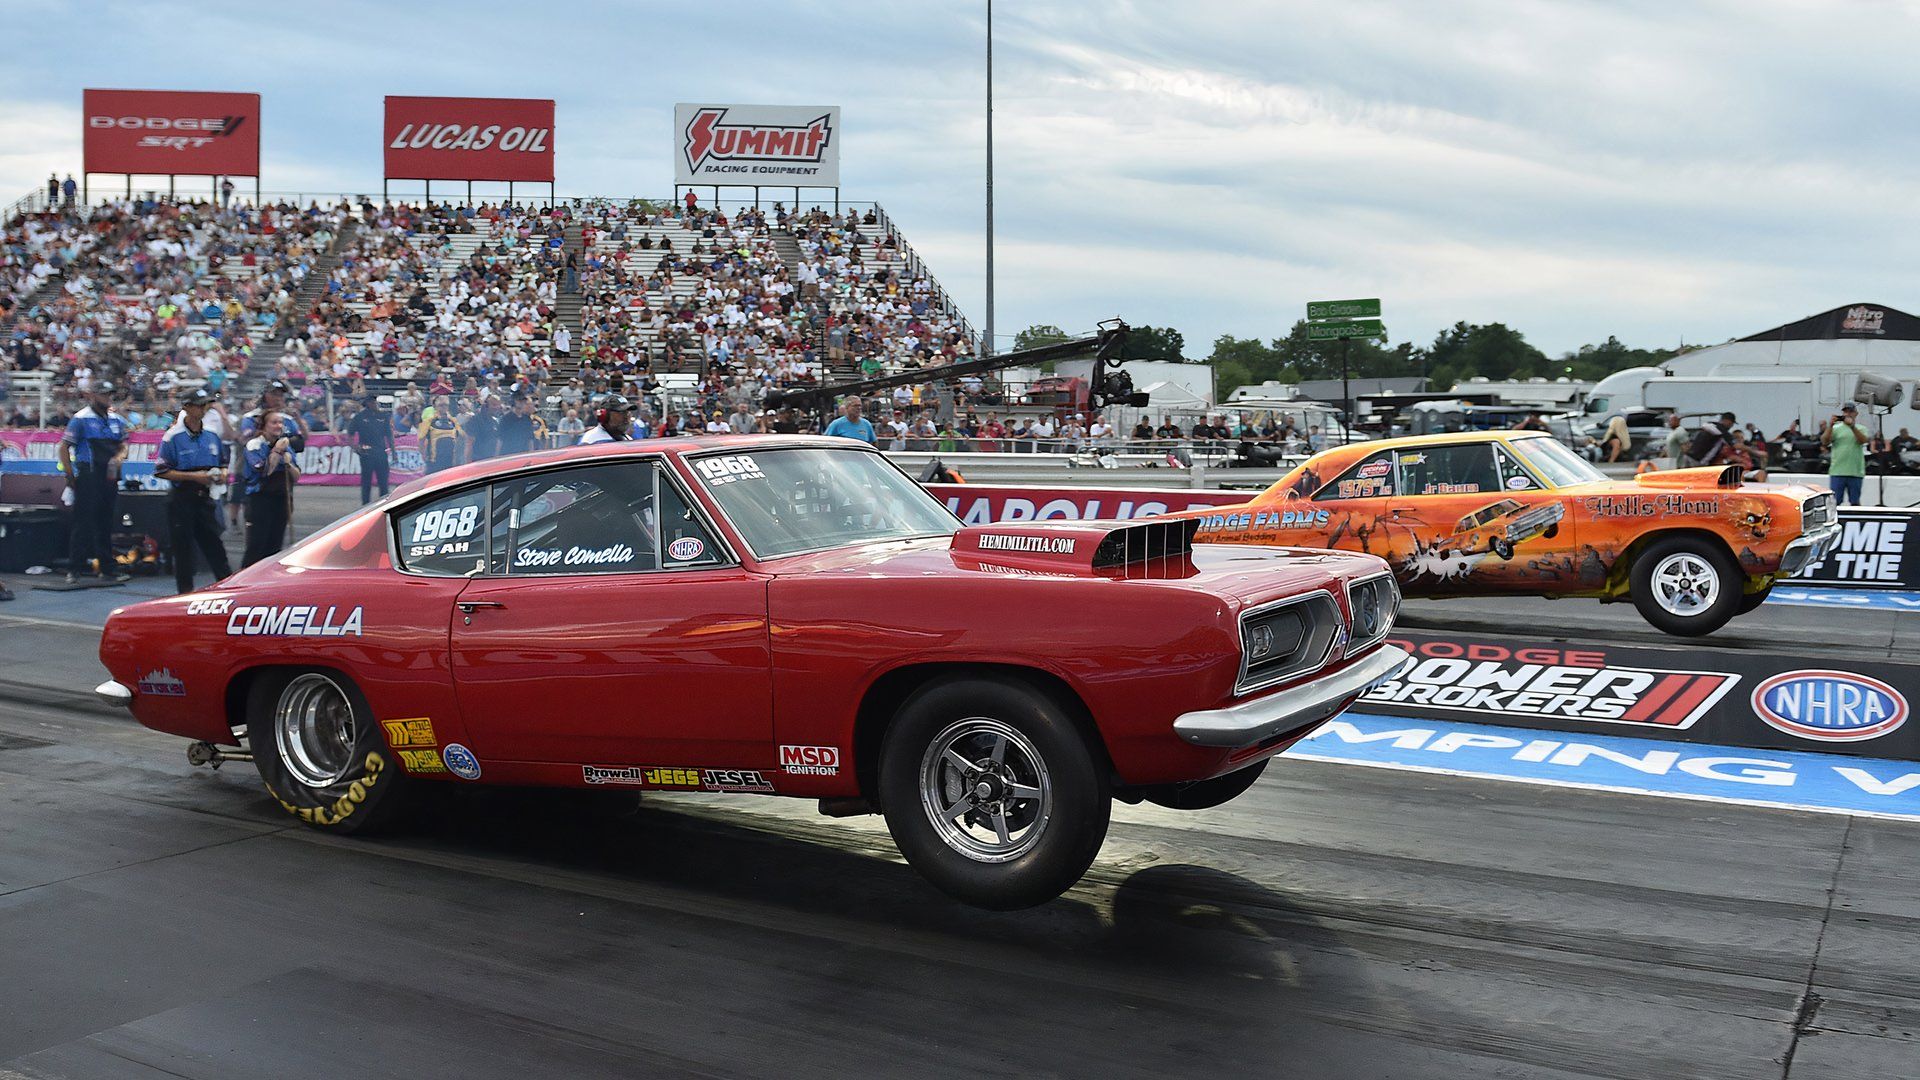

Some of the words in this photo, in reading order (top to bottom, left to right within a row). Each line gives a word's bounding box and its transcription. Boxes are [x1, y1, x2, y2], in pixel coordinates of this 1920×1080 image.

[90, 116, 225, 130] DODGE
[137, 136, 214, 150] SRT
[390, 124, 501, 151] LUCAS
[499, 126, 549, 152] OIL
[705, 165, 748, 174] RACING
[752, 166, 819, 175] EQUIPMENT
[695, 455, 760, 480] 1968
[709, 475, 737, 486] SS
[740, 471, 766, 480] AH
[412, 505, 479, 542] 1968
[1253, 510, 1330, 530] FARMS
[410, 545, 437, 556] SS
[440, 541, 469, 554] AH
[673, 540, 700, 557] NHRA
[978, 534, 1075, 554] HEMIMILITIA.COM
[514, 548, 562, 566] Steve
[564, 544, 634, 565] Comella
[1834, 553, 1902, 580] THE
[187, 599, 233, 615] CHUCK
[226, 606, 363, 636] COMELLA
[1775, 682, 1886, 726] NHRA
[783, 747, 836, 766] MSD
[584, 766, 640, 779] Browell
[648, 769, 700, 785] JEGS
[703, 770, 771, 788] JESEL
[786, 766, 836, 776] IGNITION
